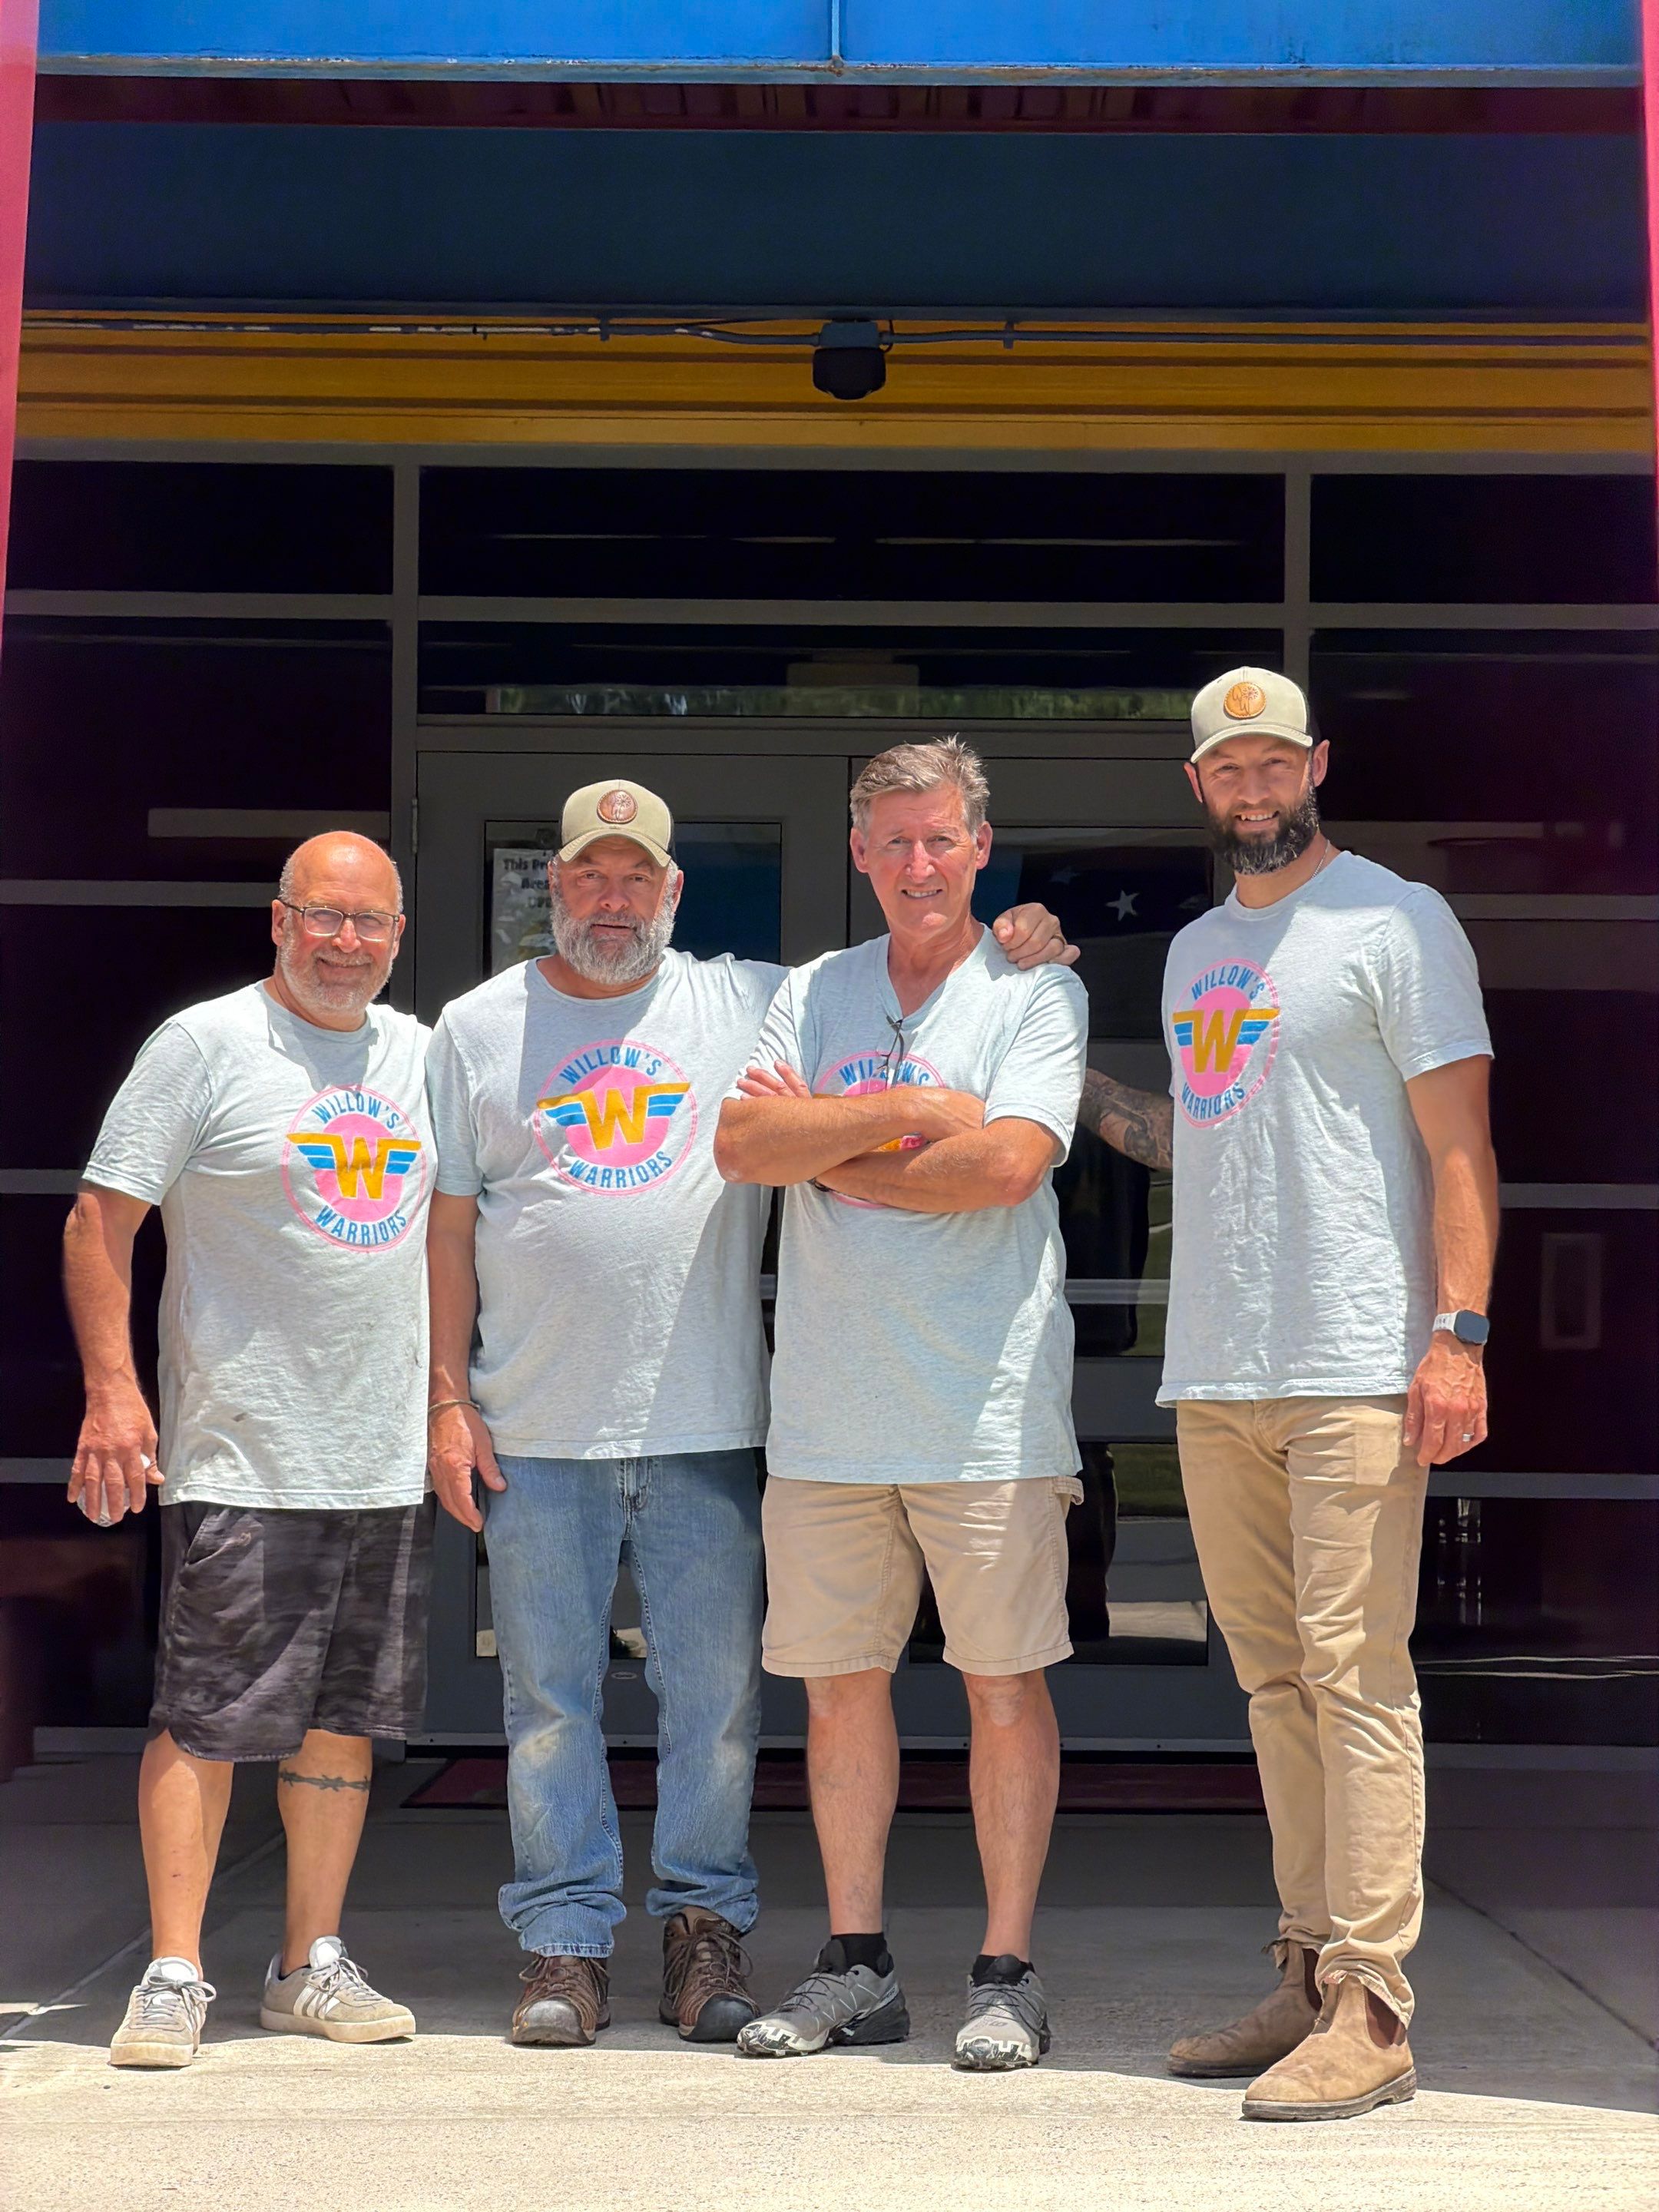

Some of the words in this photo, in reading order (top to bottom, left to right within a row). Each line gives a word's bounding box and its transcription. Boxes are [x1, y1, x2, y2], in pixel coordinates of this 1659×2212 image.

[503, 857, 528, 870] This
[1191, 965, 1265, 1001] WILLOW'S
[559, 1046, 662, 1085] WILLOW'S
[311, 1092, 400, 1130] WILLOW'S
[1181, 1081, 1246, 1120] WARRIORS
[568, 1151, 673, 1188] WARRIORS
[316, 1205, 407, 1245] WARRIORS
